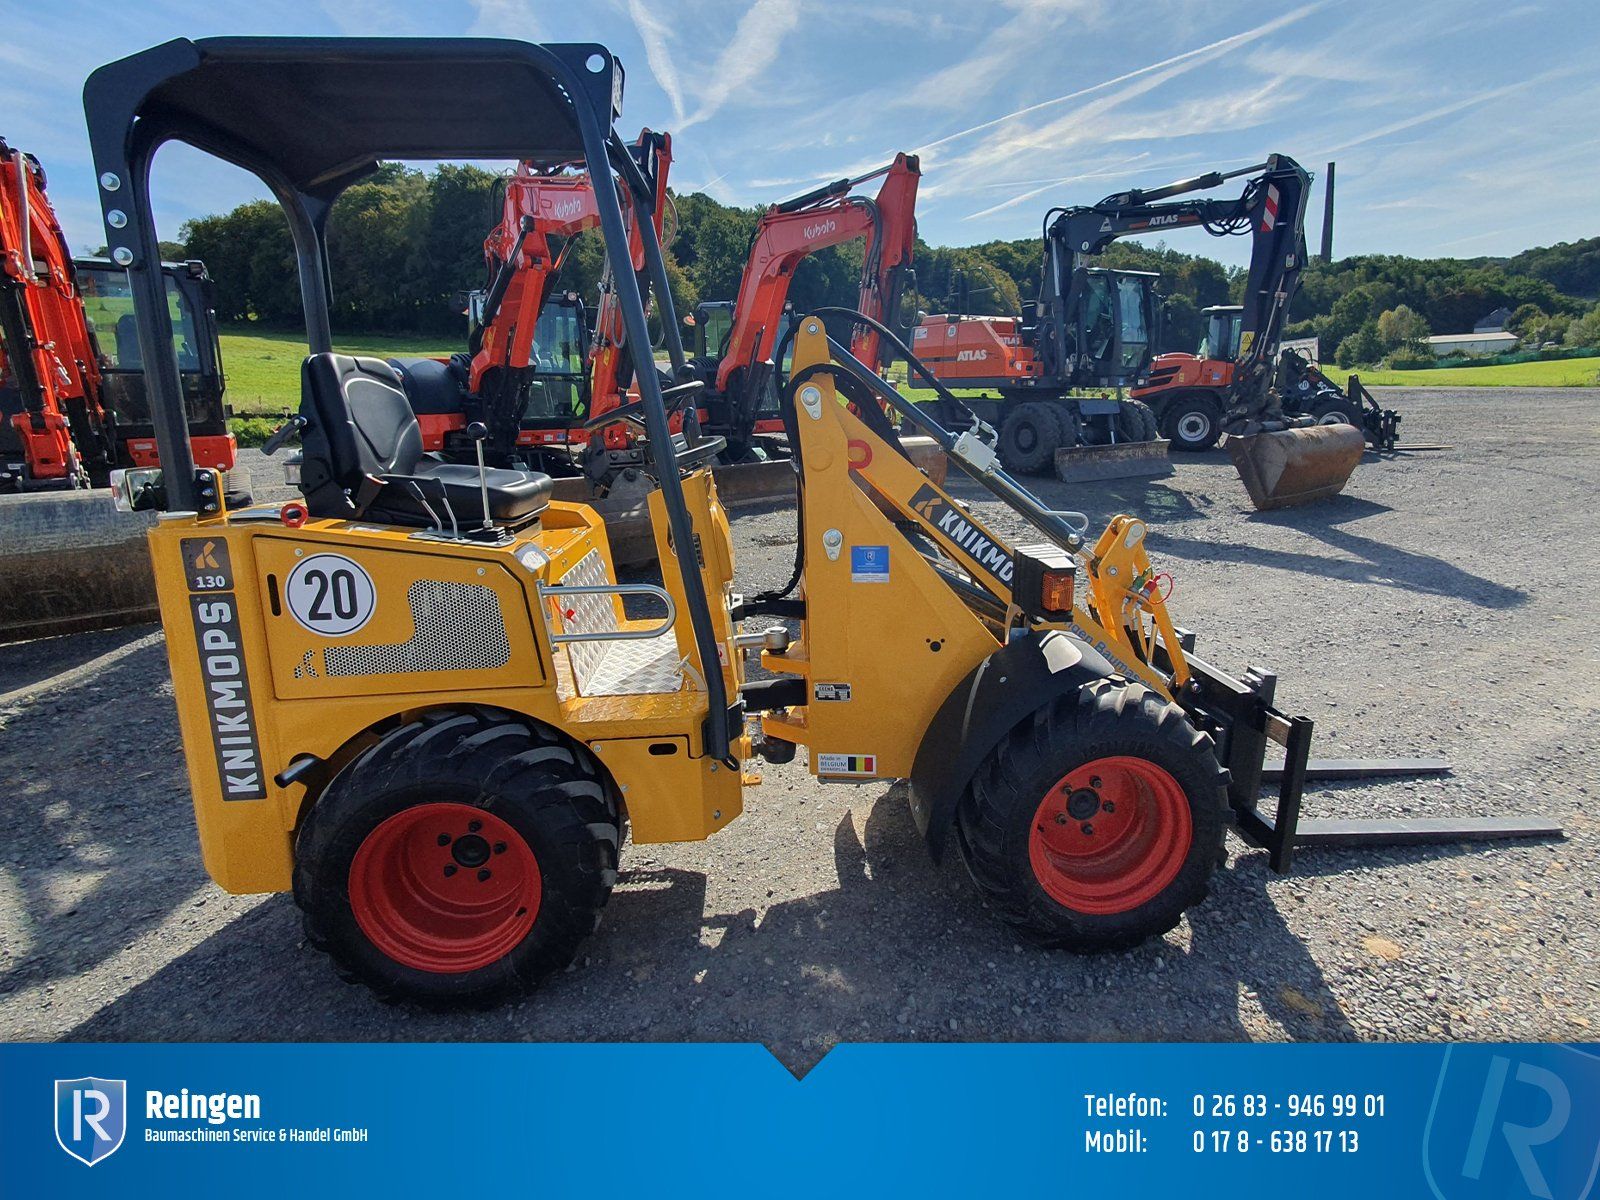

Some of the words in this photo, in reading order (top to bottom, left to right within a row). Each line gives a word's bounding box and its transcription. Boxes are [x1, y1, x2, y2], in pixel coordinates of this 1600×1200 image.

[555, 197, 581, 218] Kubota
[804, 219, 836, 239] Kubota
[1149, 214, 1179, 226] ATLAS
[957, 349, 988, 362] ATLAS
[938, 509, 1014, 582] KNIKMO
[196, 575, 226, 588] 130
[304, 569, 358, 621] 20
[198, 602, 260, 793] KNIKMOPS
